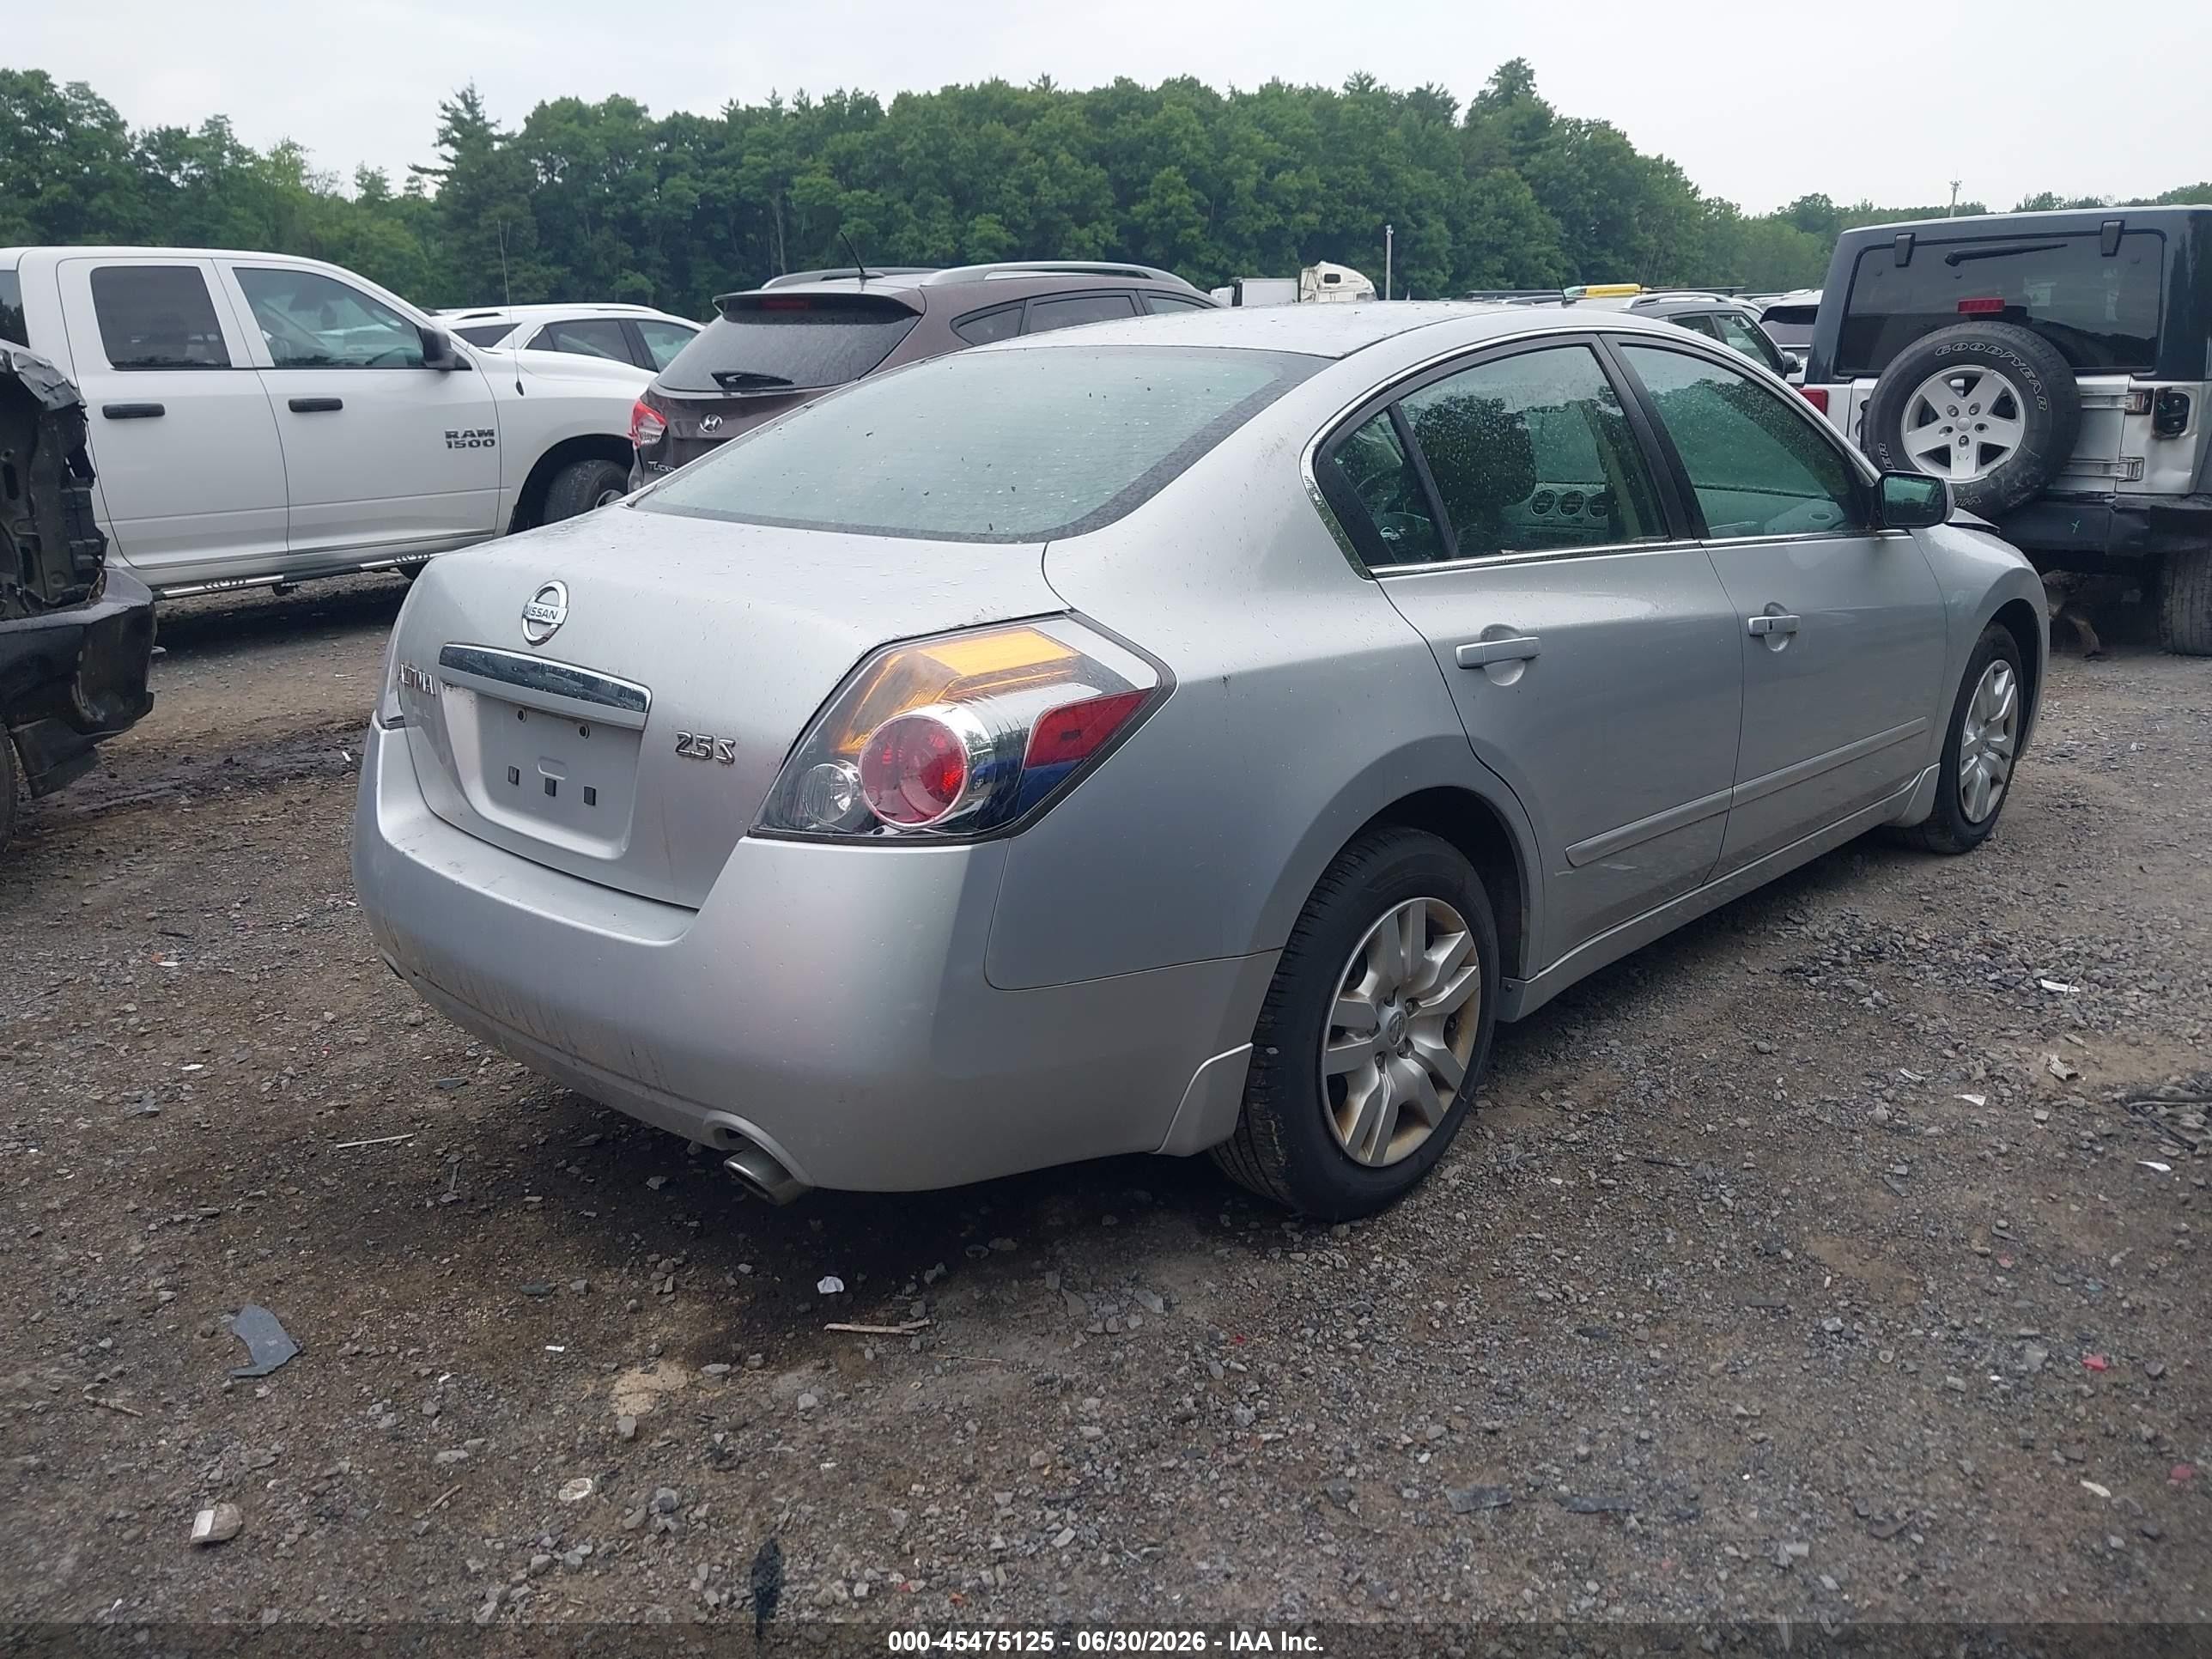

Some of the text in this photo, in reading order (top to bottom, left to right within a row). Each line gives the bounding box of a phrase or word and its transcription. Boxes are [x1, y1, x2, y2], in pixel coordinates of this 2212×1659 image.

[1935, 343, 2048, 411] GOODYEAR
[445, 429, 495, 439] RAM
[447, 438, 495, 449] 1500
[647, 460, 677, 472] TUCS
[523, 604, 559, 620] NISSAN
